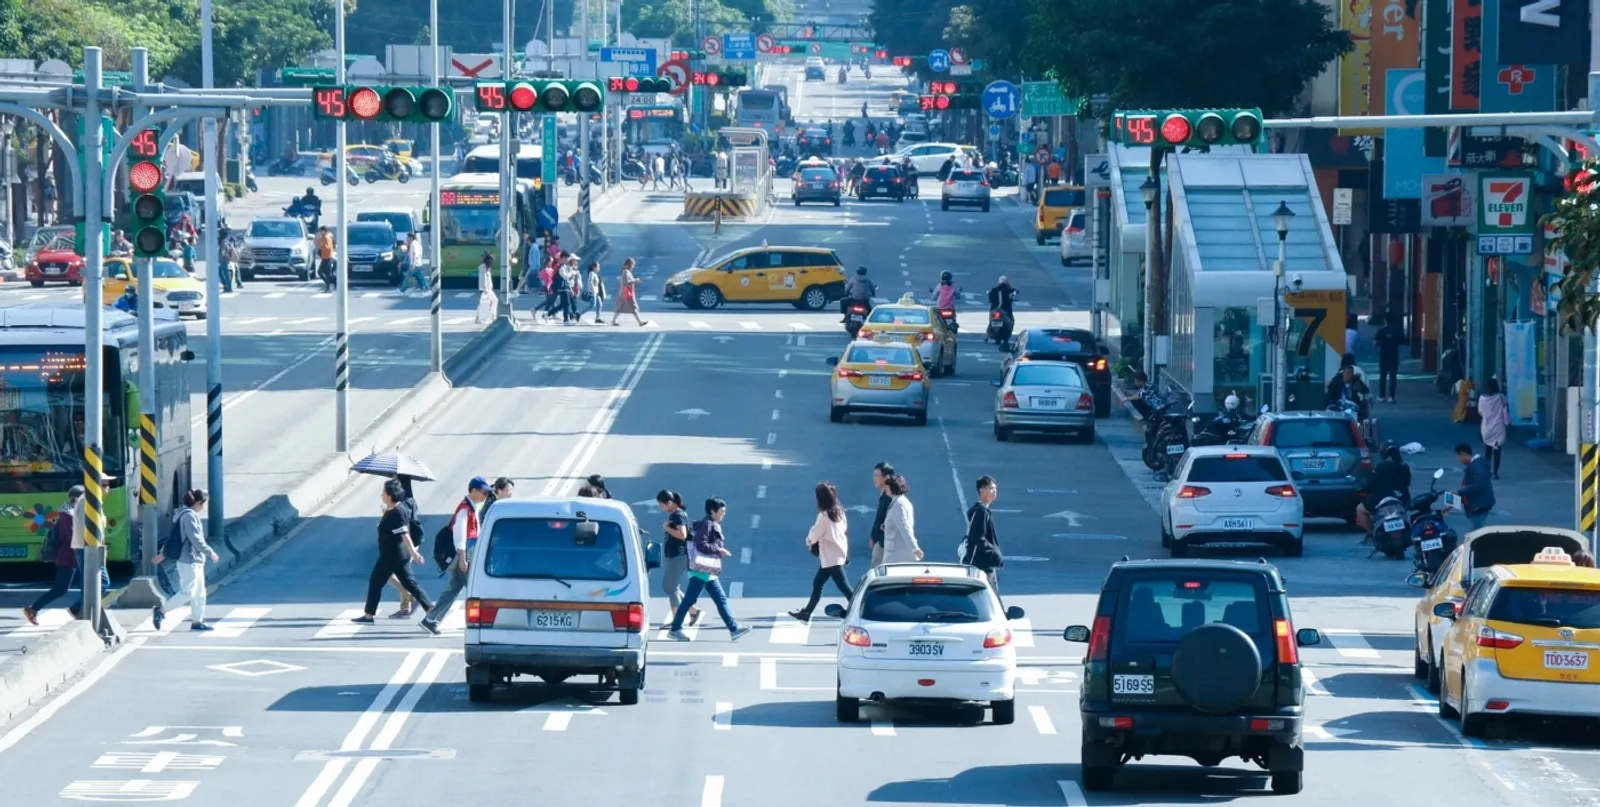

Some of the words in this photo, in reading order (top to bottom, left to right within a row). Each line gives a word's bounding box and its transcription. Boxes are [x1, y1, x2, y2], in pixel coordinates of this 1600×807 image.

[611, 79, 623, 92] 34
[694, 73, 705, 85] 34
[931, 82, 942, 94] 34
[317, 90, 345, 117] 45
[480, 87, 504, 109] 45
[922, 96, 934, 109] 34
[1128, 118, 1154, 143] 45
[132, 131, 157, 156] 45
[1294, 308, 1328, 356] 7
